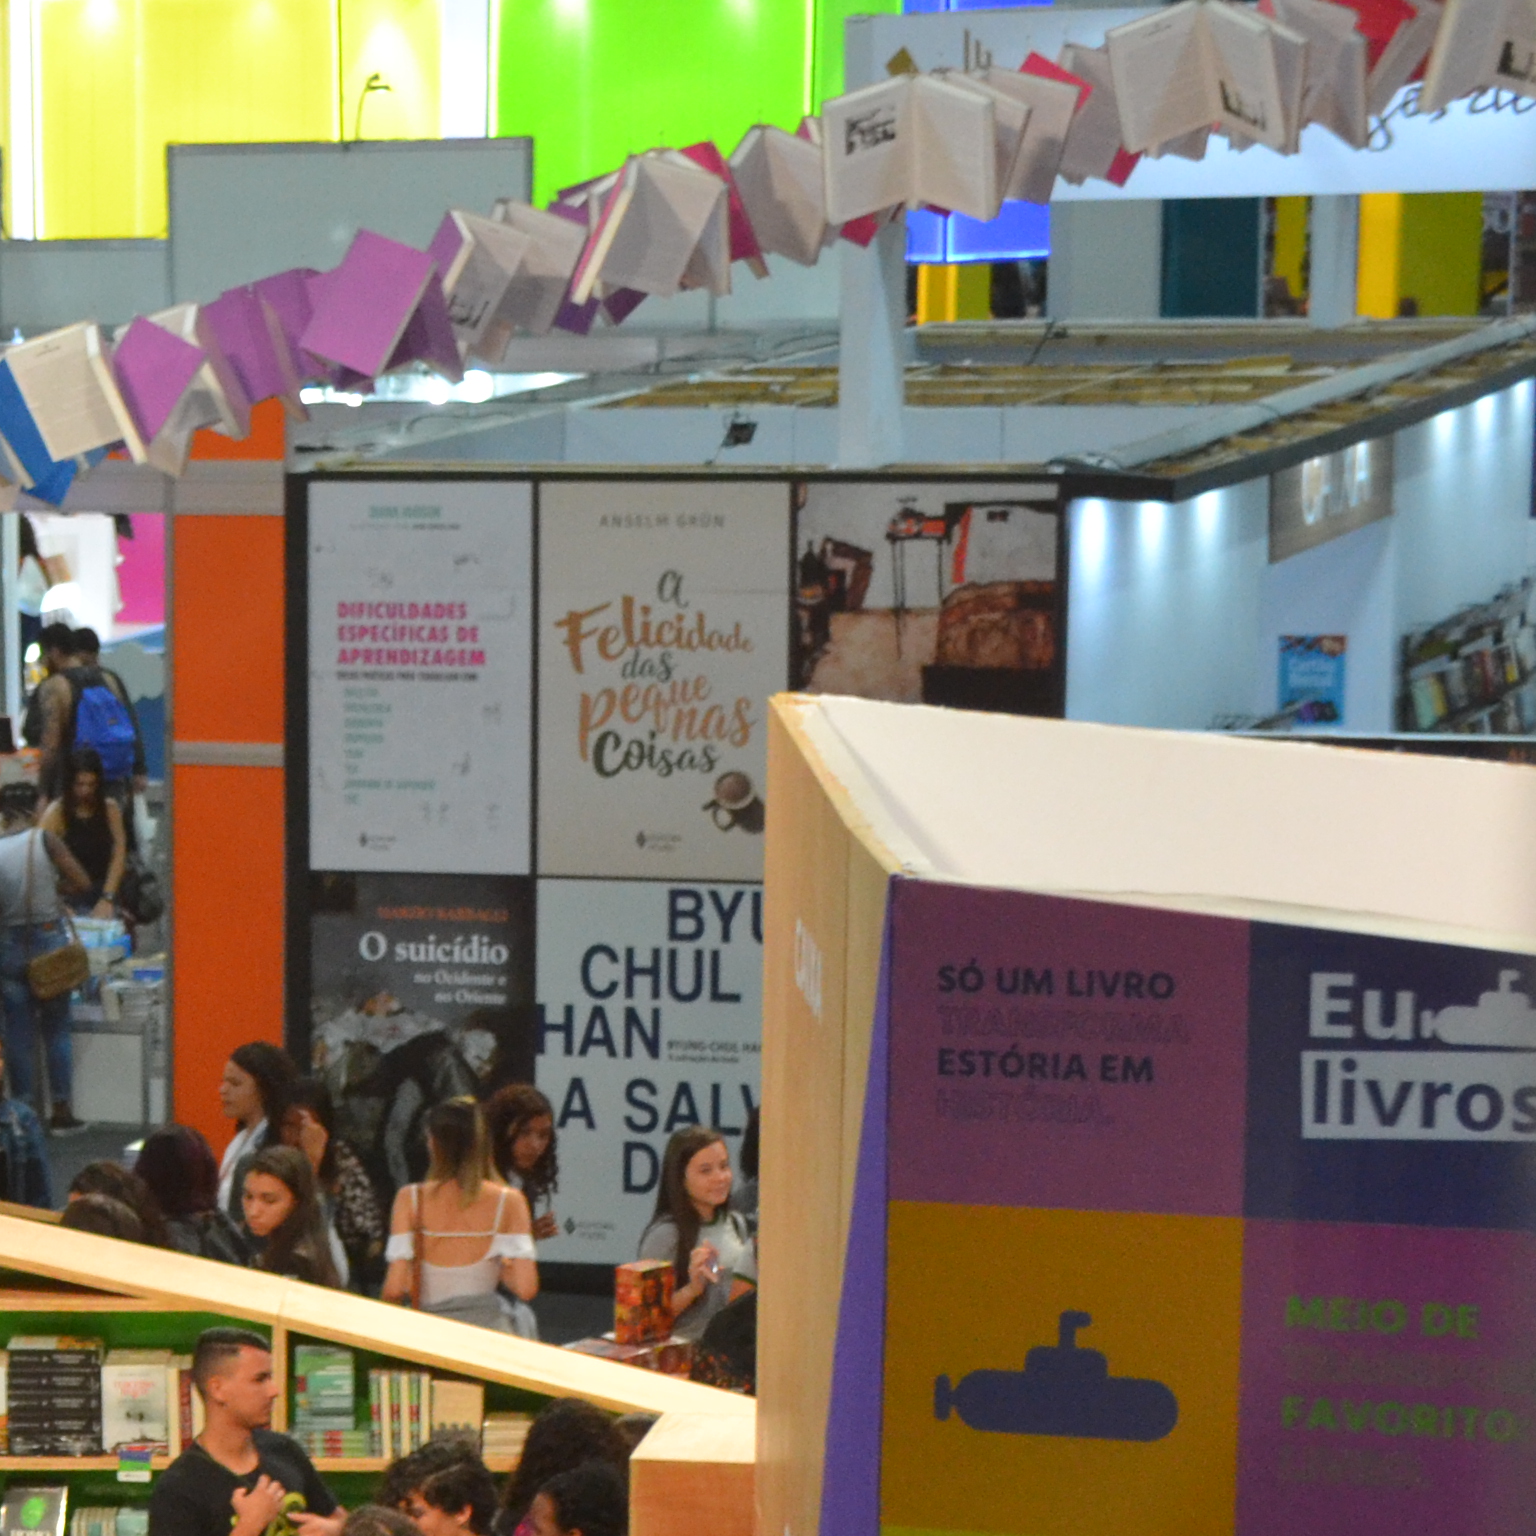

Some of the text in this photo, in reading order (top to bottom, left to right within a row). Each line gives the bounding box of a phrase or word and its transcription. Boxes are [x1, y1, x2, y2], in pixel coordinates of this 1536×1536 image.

[600, 514, 670, 528] ANSELM
[338, 602, 467, 619] DIFICULDADES
[338, 621, 479, 643] ESPECÍFICAS DE
[553, 595, 754, 675] Felicidade
[338, 648, 486, 665] APRENDIZAGEM
[621, 649, 676, 683] das
[592, 729, 721, 778] Coisas
[359, 931, 509, 966] O suicídio
[581, 944, 741, 1003] CHUL
[937, 963, 1175, 1001] SÓ UM LIVRO
[537, 1003, 660, 1059] HAN
[937, 1043, 1156, 1084] ESTÓRIA EM
[558, 1077, 596, 1129] A
[1285, 1295, 1481, 1339] MEIO DE
